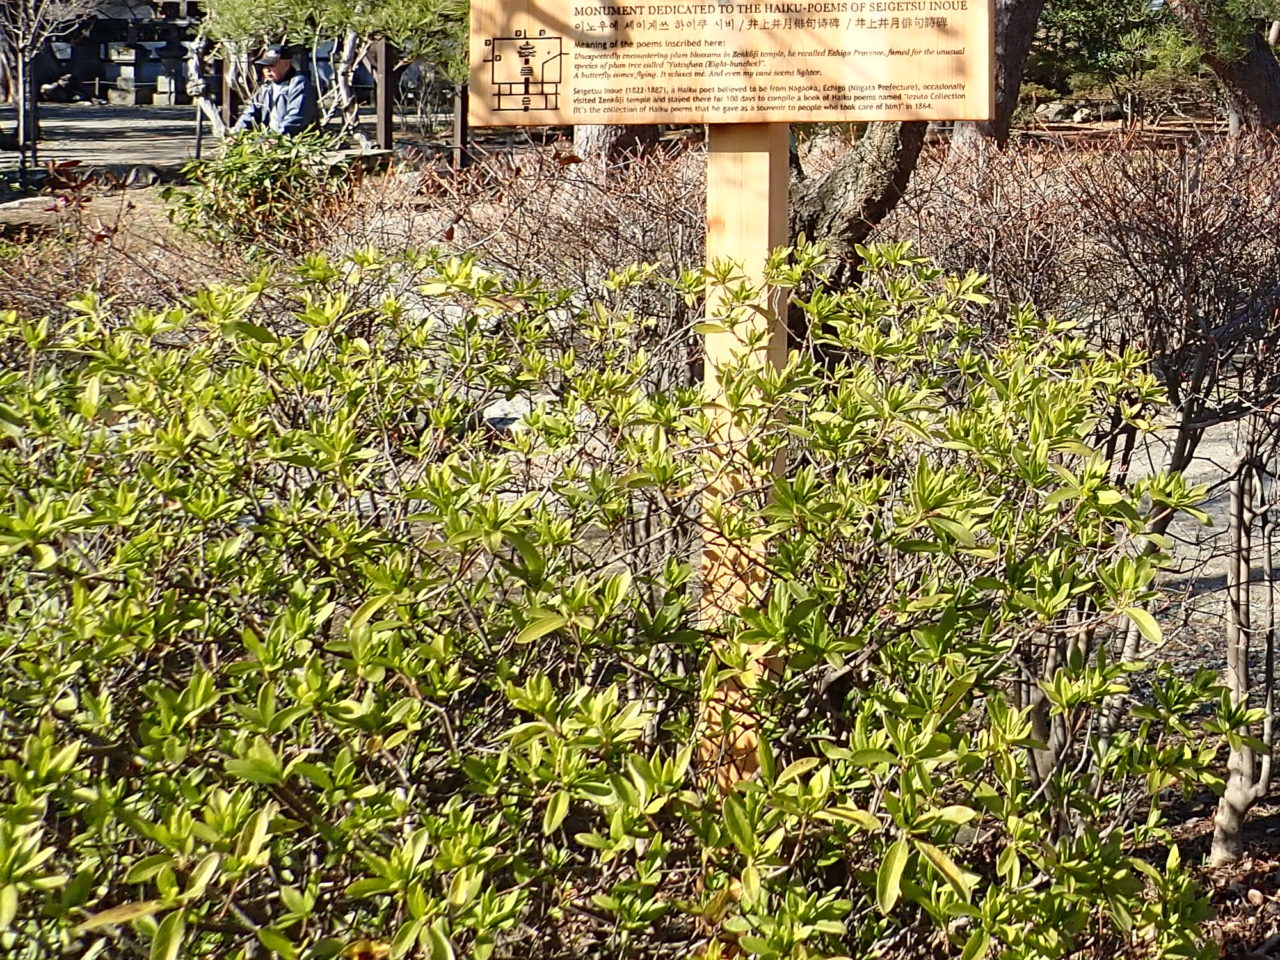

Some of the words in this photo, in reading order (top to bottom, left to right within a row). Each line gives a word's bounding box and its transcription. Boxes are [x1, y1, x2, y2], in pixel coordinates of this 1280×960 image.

[574, 5, 645, 16] MONUMENT
[648, 4, 716, 15] DEDICATED
[718, 3, 734, 14] TO
[736, 3, 762, 14] THE
[764, 2, 848, 13] HAIKU-POEMS
[850, 2, 866, 12] OF
[869, 1, 926, 12] SEIGETSU
[575, 20, 618, 32] 이노우에
[675, 19, 707, 31] 하이쿠
[715, 19, 734, 31] 시비
[575, 40, 608, 51] Meaning
[609, 40, 618, 48] of
[620, 39, 634, 48] the
[636, 41, 662, 50] poems
[665, 39, 702, 47] inscribed
[704, 38, 726, 46] here:
[573, 87, 602, 96] Seigetsu
[604, 86, 623, 94] Inoue
[677, 85, 697, 93] Haiku
[699, 85, 715, 95] poet
[717, 85, 750, 93] believed
[769, 84, 787, 92] from
[788, 84, 821, 94] Nagaoka,
[822, 84, 846, 93] Echigo
[877, 83, 920, 93] Prefecture),
[922, 83, 966, 92] occasionally
[573, 96, 596, 104] visited
[626, 96, 651, 105] temple
[652, 95, 665, 103] and
[667, 95, 690, 105] stayed
[692, 95, 712, 103] there
[740, 94, 756, 104] days
[757, 94, 766, 102] to
[767, 94, 795, 104] compile
[831, 93, 852, 101] Haiku
[853, 95, 876, 103] poems
[930, 92, 966, 100] Collection
[603, 105, 638, 113] collection
[639, 105, 647, 113] of
[670, 106, 693, 114] poems
[694, 104, 709, 112] that
[711, 104, 721, 112] he
[722, 106, 738, 114] gave
[797, 103, 822, 113] people
[823, 103, 839, 111] who
[840, 103, 856, 111] took
[905, 102, 913, 110] in
